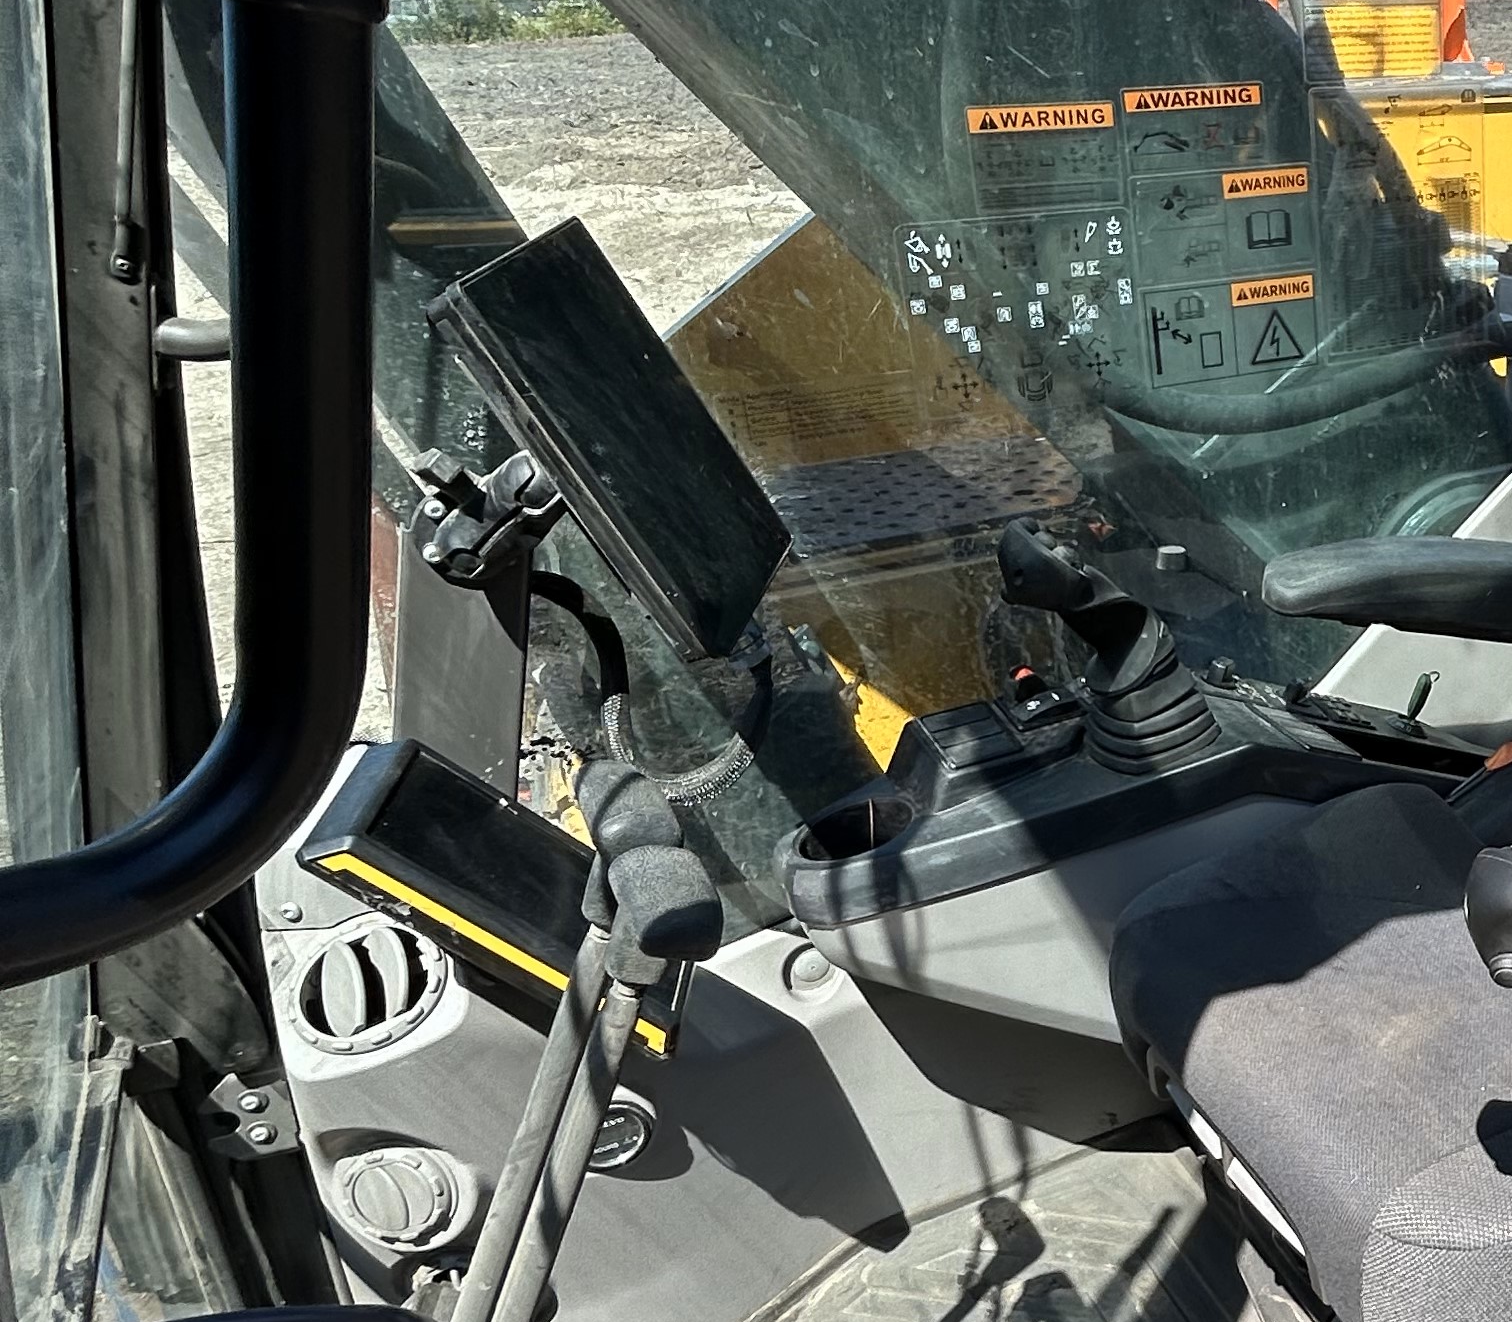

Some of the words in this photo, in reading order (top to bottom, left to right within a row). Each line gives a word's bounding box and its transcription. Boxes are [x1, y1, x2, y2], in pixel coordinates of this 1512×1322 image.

[1150, 88, 1253, 109] WARNING
[999, 108, 1105, 128] WARNING
[1239, 173, 1305, 191] WARNING
[1248, 281, 1310, 299] WARNING
